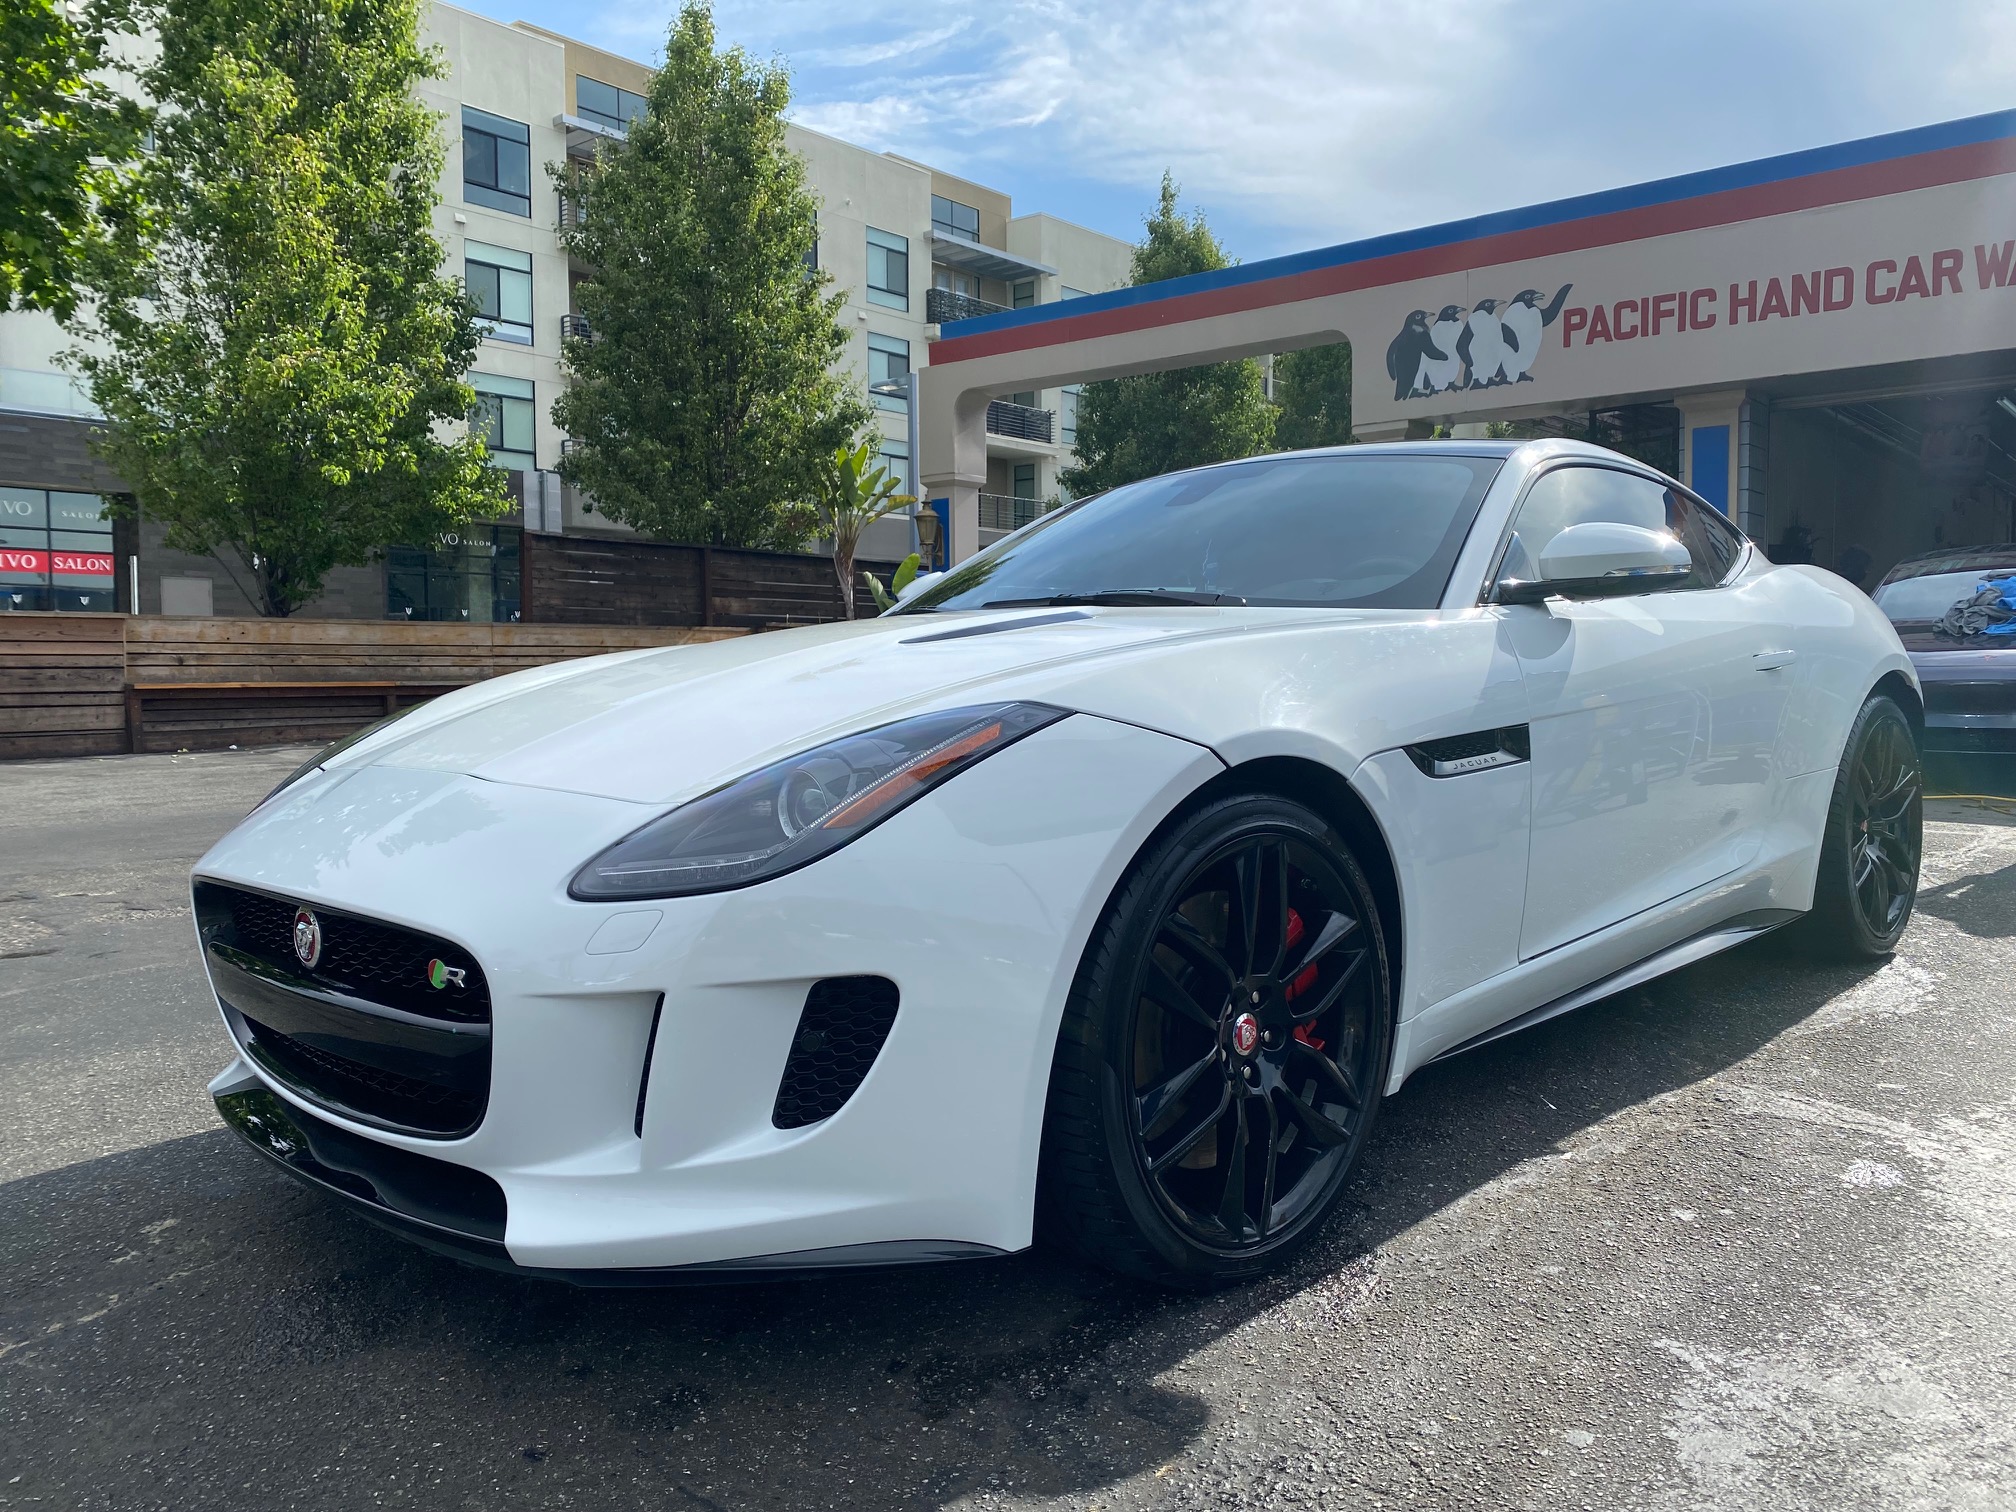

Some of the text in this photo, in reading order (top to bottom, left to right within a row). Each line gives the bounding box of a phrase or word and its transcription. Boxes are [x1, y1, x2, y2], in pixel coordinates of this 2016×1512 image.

[1562, 239, 2016, 348] PACIFIC HAND CAR W
[0, 500, 32, 516] VO
[437, 532, 491, 547] VO SALON
[54, 556, 110, 571] SALON
[1453, 756, 1498, 770] JAGUAR
[440, 966, 466, 988] R
